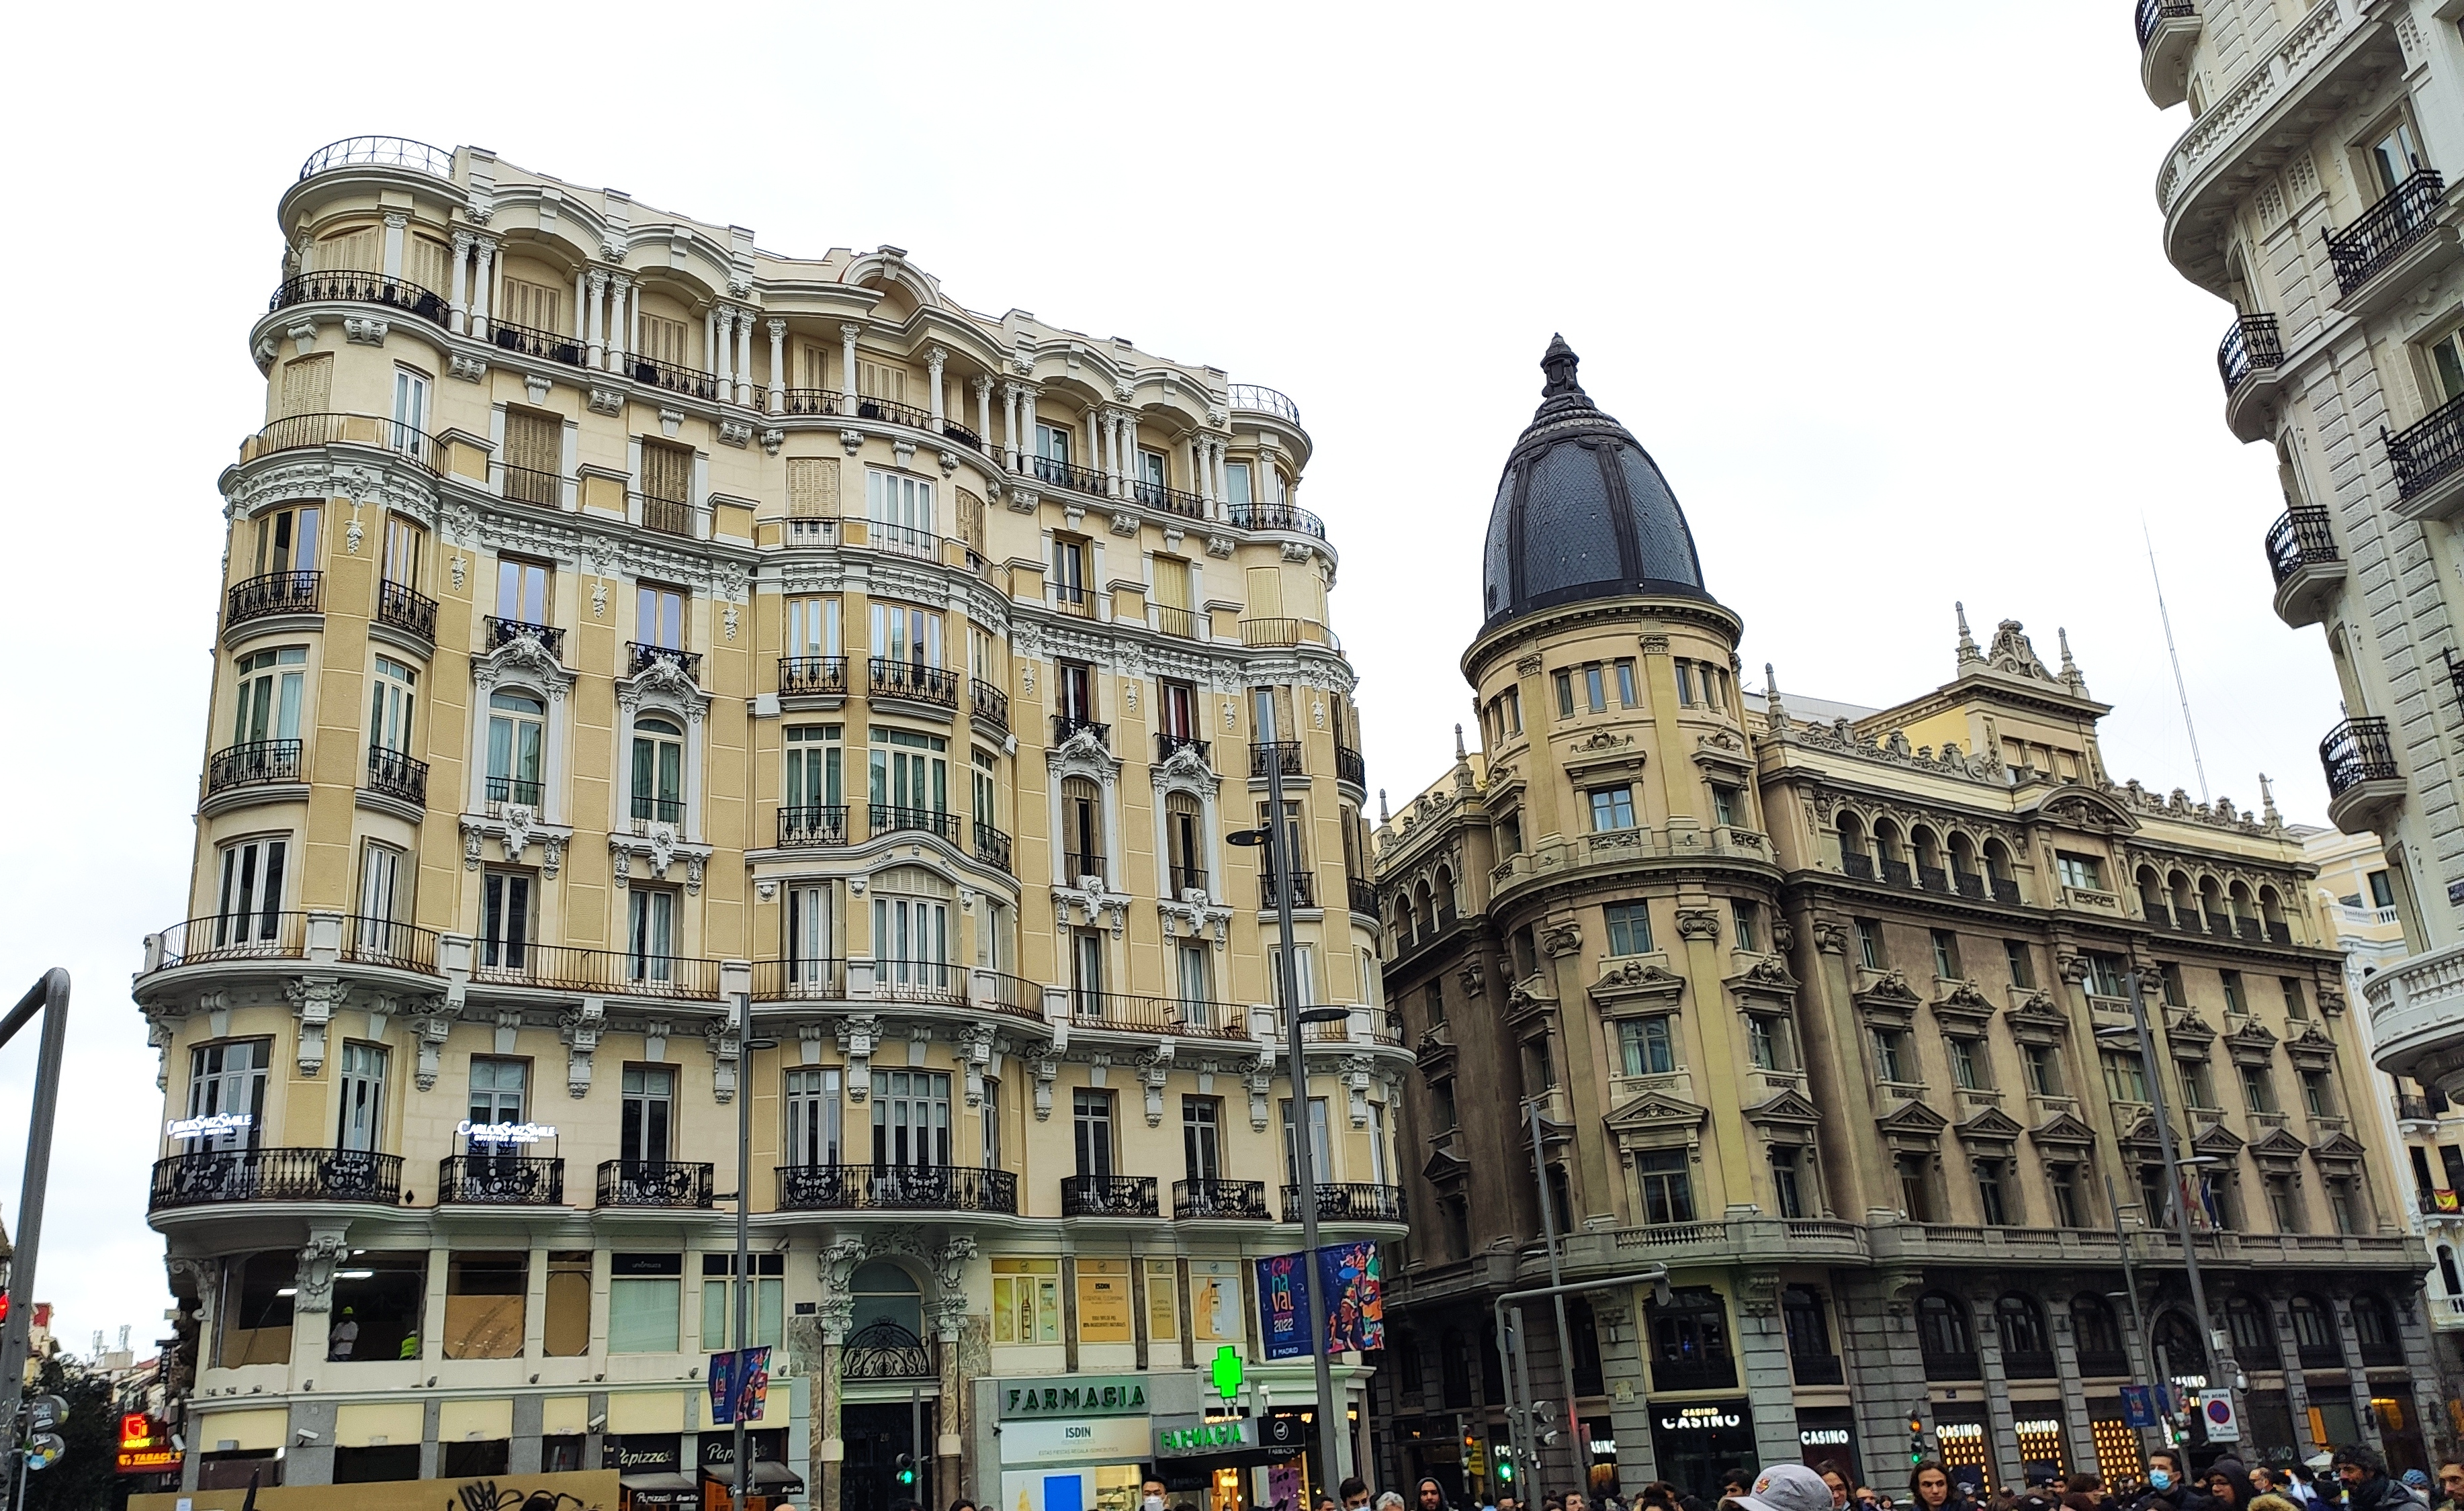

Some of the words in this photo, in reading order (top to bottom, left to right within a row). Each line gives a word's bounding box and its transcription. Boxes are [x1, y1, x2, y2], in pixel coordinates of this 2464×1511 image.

[1274, 1318, 1294, 1333] 2022
[1008, 1385, 1145, 1410] FARMACIA
[1681, 1408, 1718, 1417] CASINO
[1065, 1426, 1091, 1438] ISDIN
[1161, 1423, 1243, 1451] FARMACIA
[1801, 1430, 1849, 1445] CASINO
